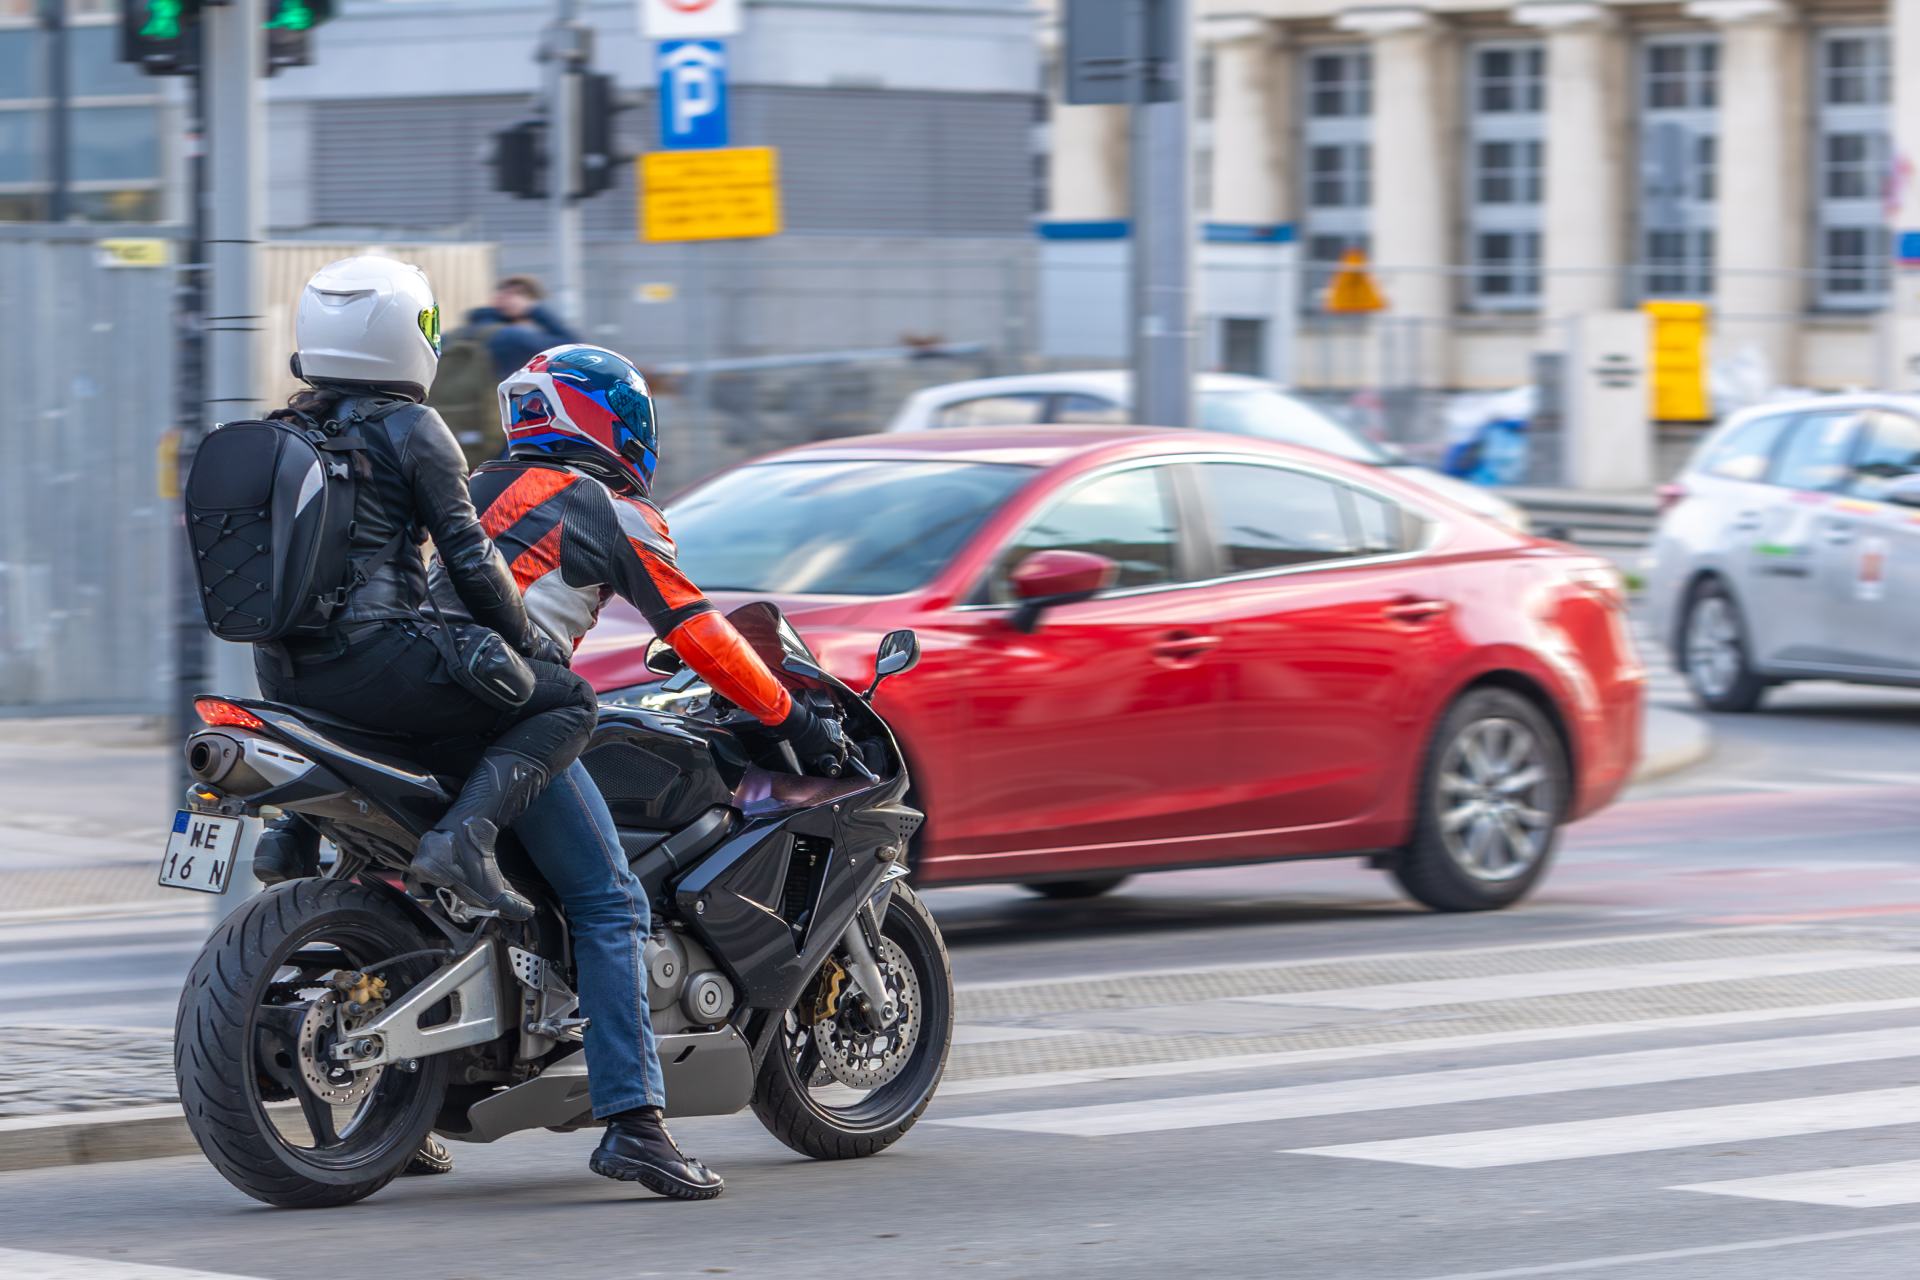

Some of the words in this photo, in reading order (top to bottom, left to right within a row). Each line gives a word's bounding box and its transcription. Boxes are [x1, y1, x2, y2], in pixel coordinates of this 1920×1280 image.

[671, 66, 720, 135] P
[168, 852, 195, 880] 16
[208, 859, 225, 886] N
